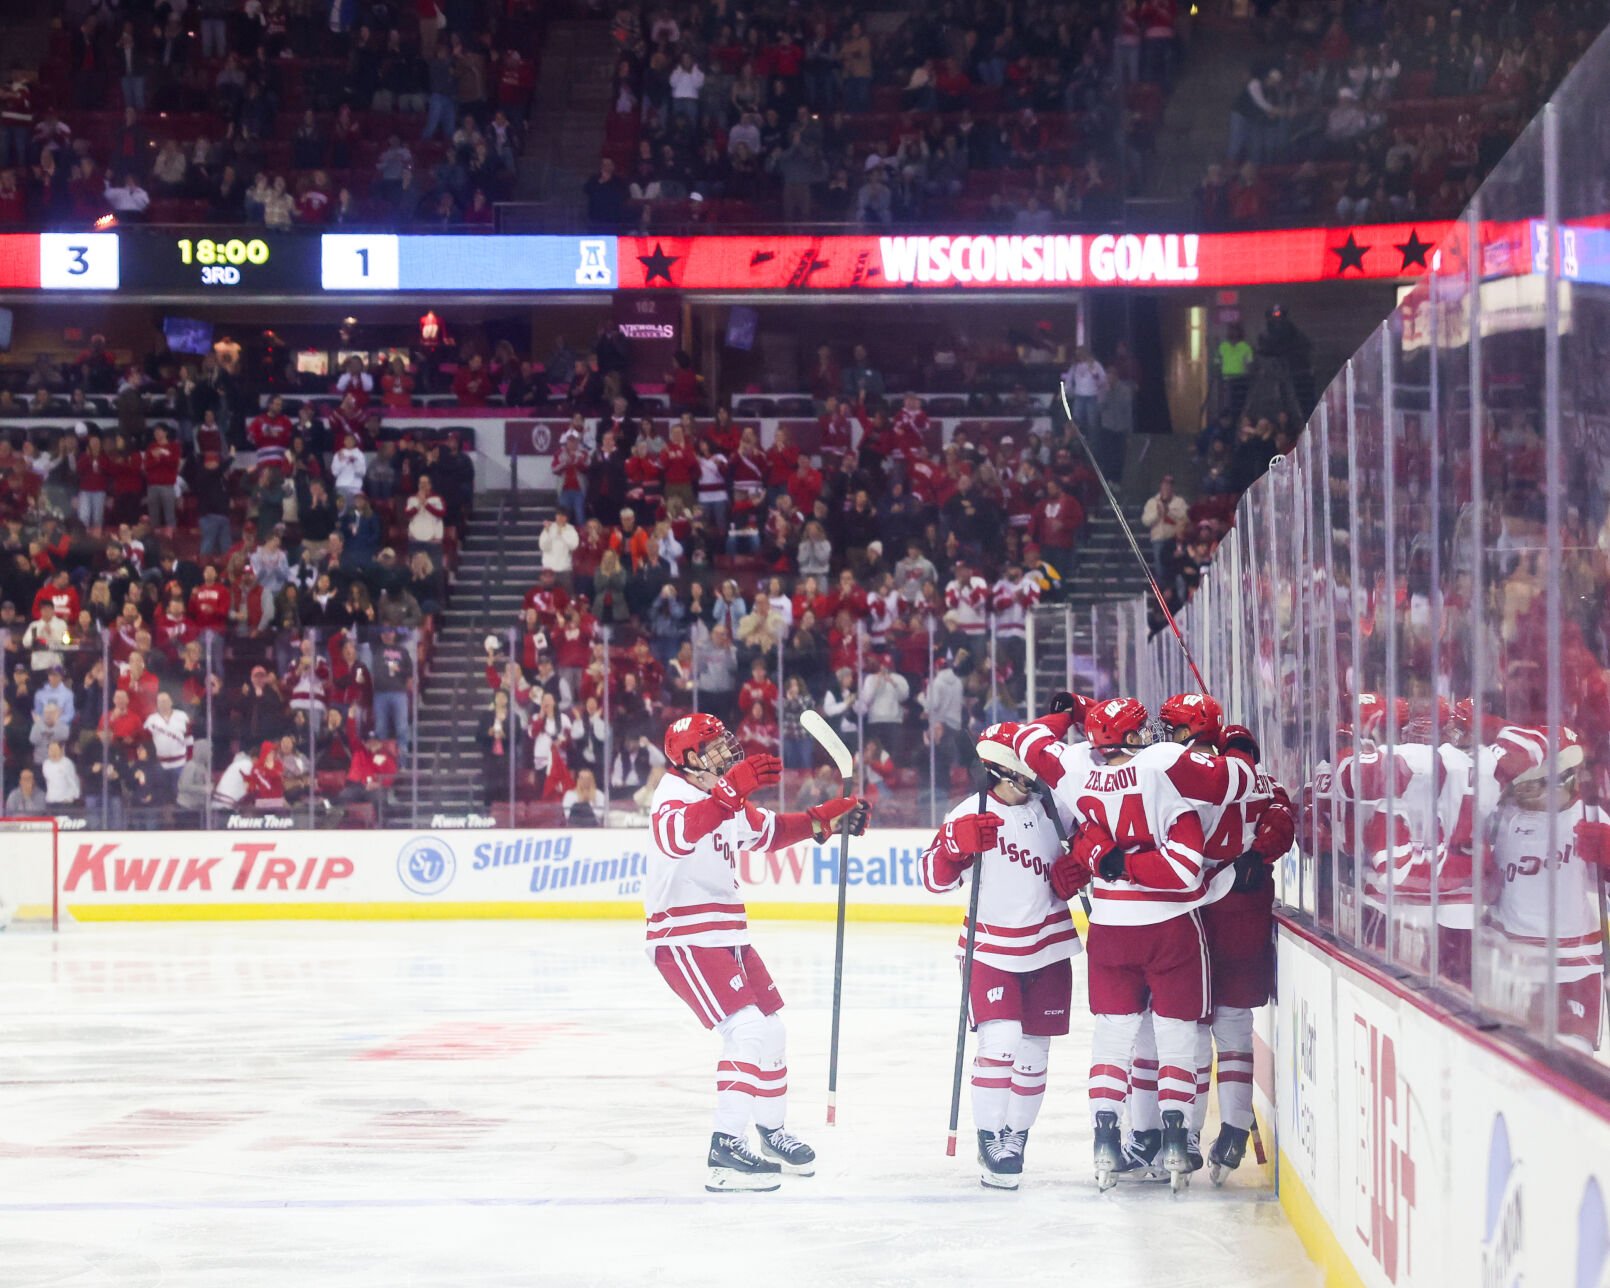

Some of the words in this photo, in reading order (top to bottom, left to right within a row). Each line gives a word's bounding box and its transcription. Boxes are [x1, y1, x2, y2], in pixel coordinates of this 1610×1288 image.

[67, 246, 89, 275] 3
[177, 239, 269, 265] 18:00
[355, 248, 369, 277] 1
[879, 235, 1083, 282] WISCONSIN
[1089, 234, 1199, 282] GOAL!
[201, 266, 240, 285] 3RD
[1085, 766, 1138, 792] ZELENOV
[63, 844, 223, 891] KWIK
[231, 843, 354, 891] TRIP
[472, 836, 572, 870] Siding
[617, 880, 642, 895] LLC
